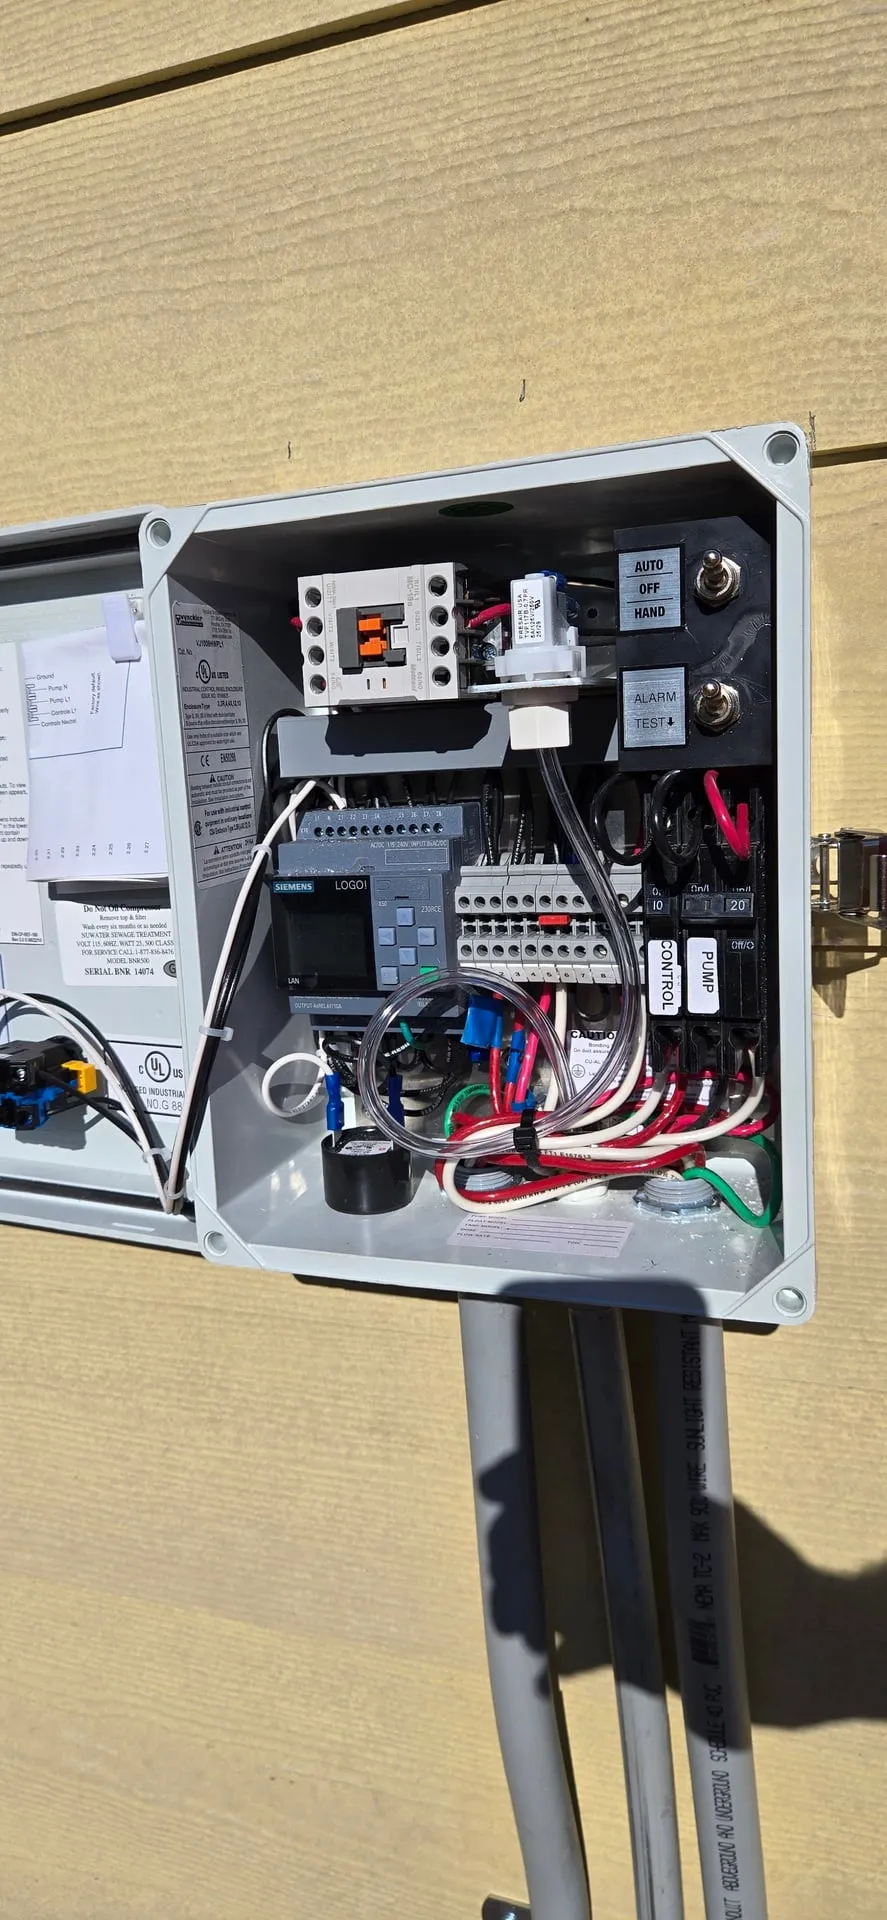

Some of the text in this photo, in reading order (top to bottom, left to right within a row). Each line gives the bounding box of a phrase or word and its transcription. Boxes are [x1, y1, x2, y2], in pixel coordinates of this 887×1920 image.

[634, 559, 664, 573] AUTO
[639, 582, 660, 595] OFF
[634, 606, 666, 619] HAND
[634, 691, 677, 704] ALARM
[635, 717, 666, 729] TEST
[275, 880, 368, 891] SIEMENS LOGO!
[730, 900, 746, 911] 20
[136, 930, 172, 938] TREATMENT
[84, 967, 155, 976] SERIAL BNR 14074
[660, 940, 674, 1010] CONTROL
[702, 951, 714, 993] PUMP
[288, 977, 300, 985] LAN
[570, 1030, 615, 1040] CAUTIO
[138, 1065, 144, 1075] C
[172, 1068, 184, 1079] US
[680, 1330, 702, 1390] RESISTANT
[683, 1396, 706, 1451] SUNLIGHT
[687, 1462, 707, 1490] WIRE
[692, 1553, 712, 1578] TC-2
[711, 1770, 734, 1823] UNDERGROUND
[716, 1824, 735, 1840] AND
[718, 1841, 740, 1892] ABOVEGROUND
